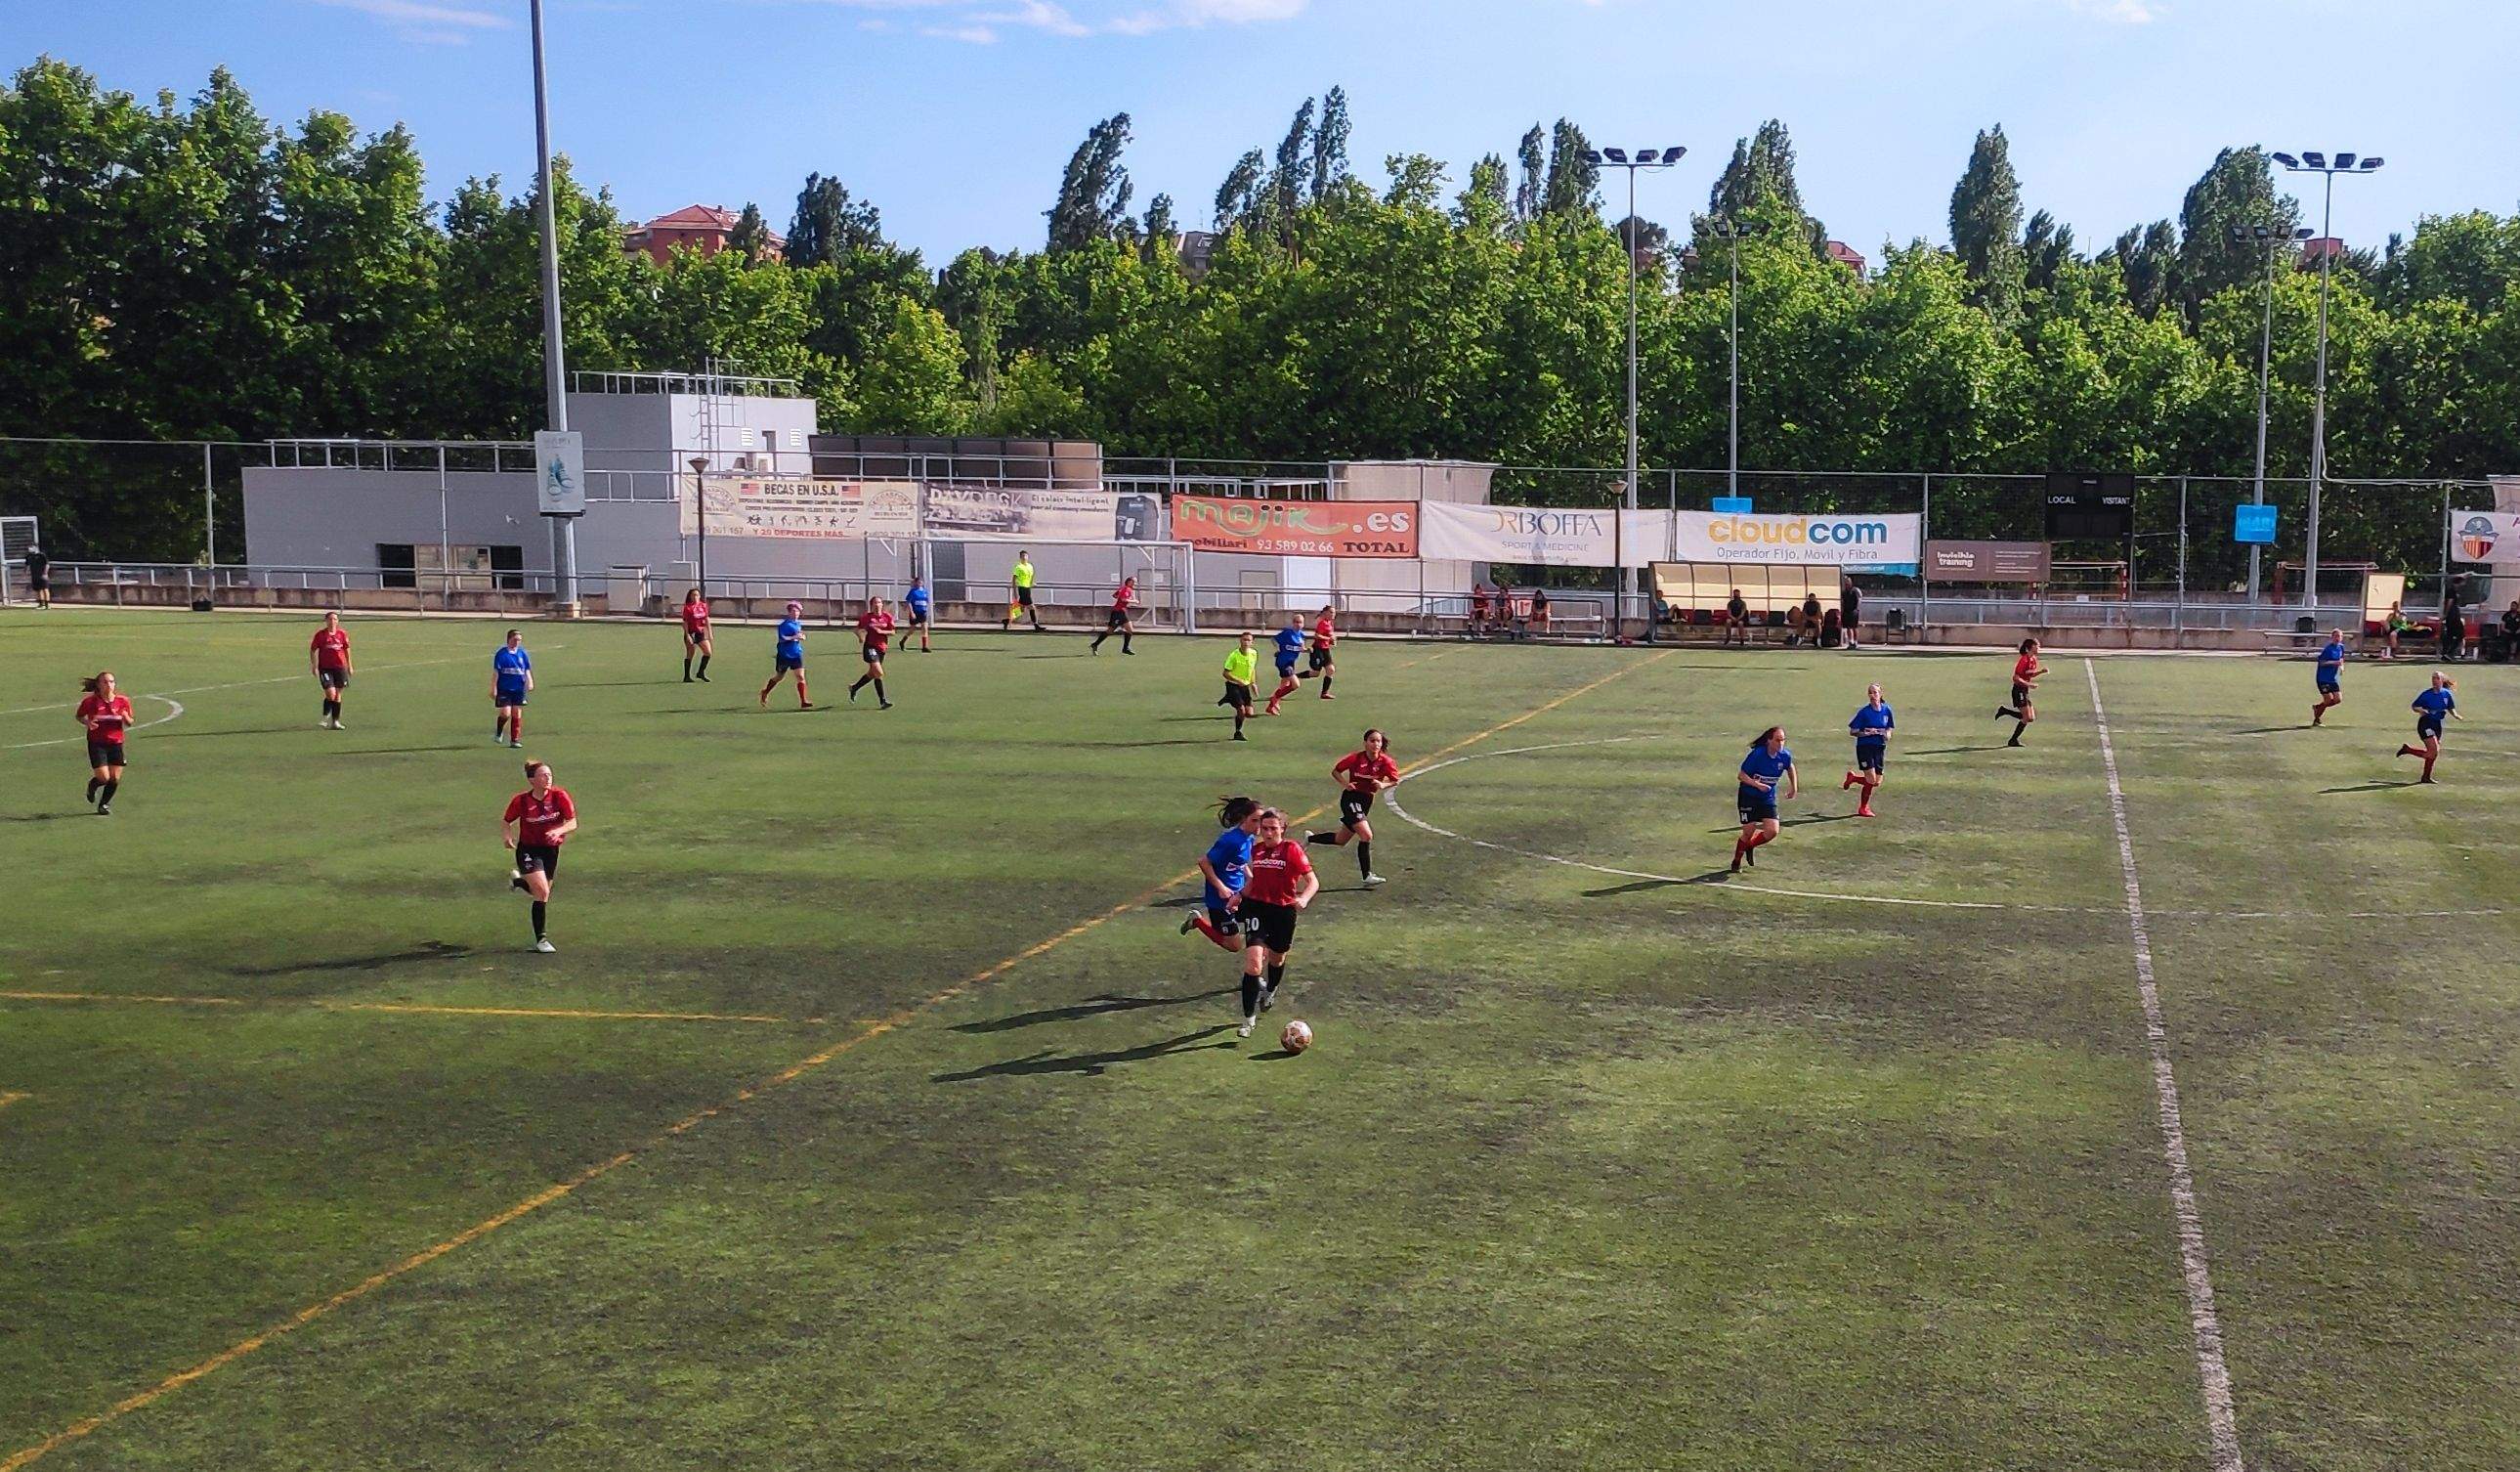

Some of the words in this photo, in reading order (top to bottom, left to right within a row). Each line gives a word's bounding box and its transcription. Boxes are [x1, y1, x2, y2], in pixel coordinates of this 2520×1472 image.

[764, 483, 795, 496] BECAS
[797, 485, 810, 497] EN
[812, 484, 839, 497] U.S.A.
[2047, 496, 2076, 504] LOCAL
[2102, 497, 2131, 505] VISITANT
[774, 529, 822, 538] DEPORTES
[1709, 516, 1887, 544] cloudcom
[1257, 539, 1271, 550] 93
[1275, 539, 1298, 551] 589
[1301, 541, 1315, 552] 02
[1318, 541, 1334, 553] 66
[1343, 541, 1410, 553] TOTAL
[1502, 541, 1532, 549] SPORT
[1717, 546, 1771, 559] Operador
[1838, 550, 1845, 562] y
[1849, 548, 1878, 560] Fibra
[1939, 558, 1974, 568] training
